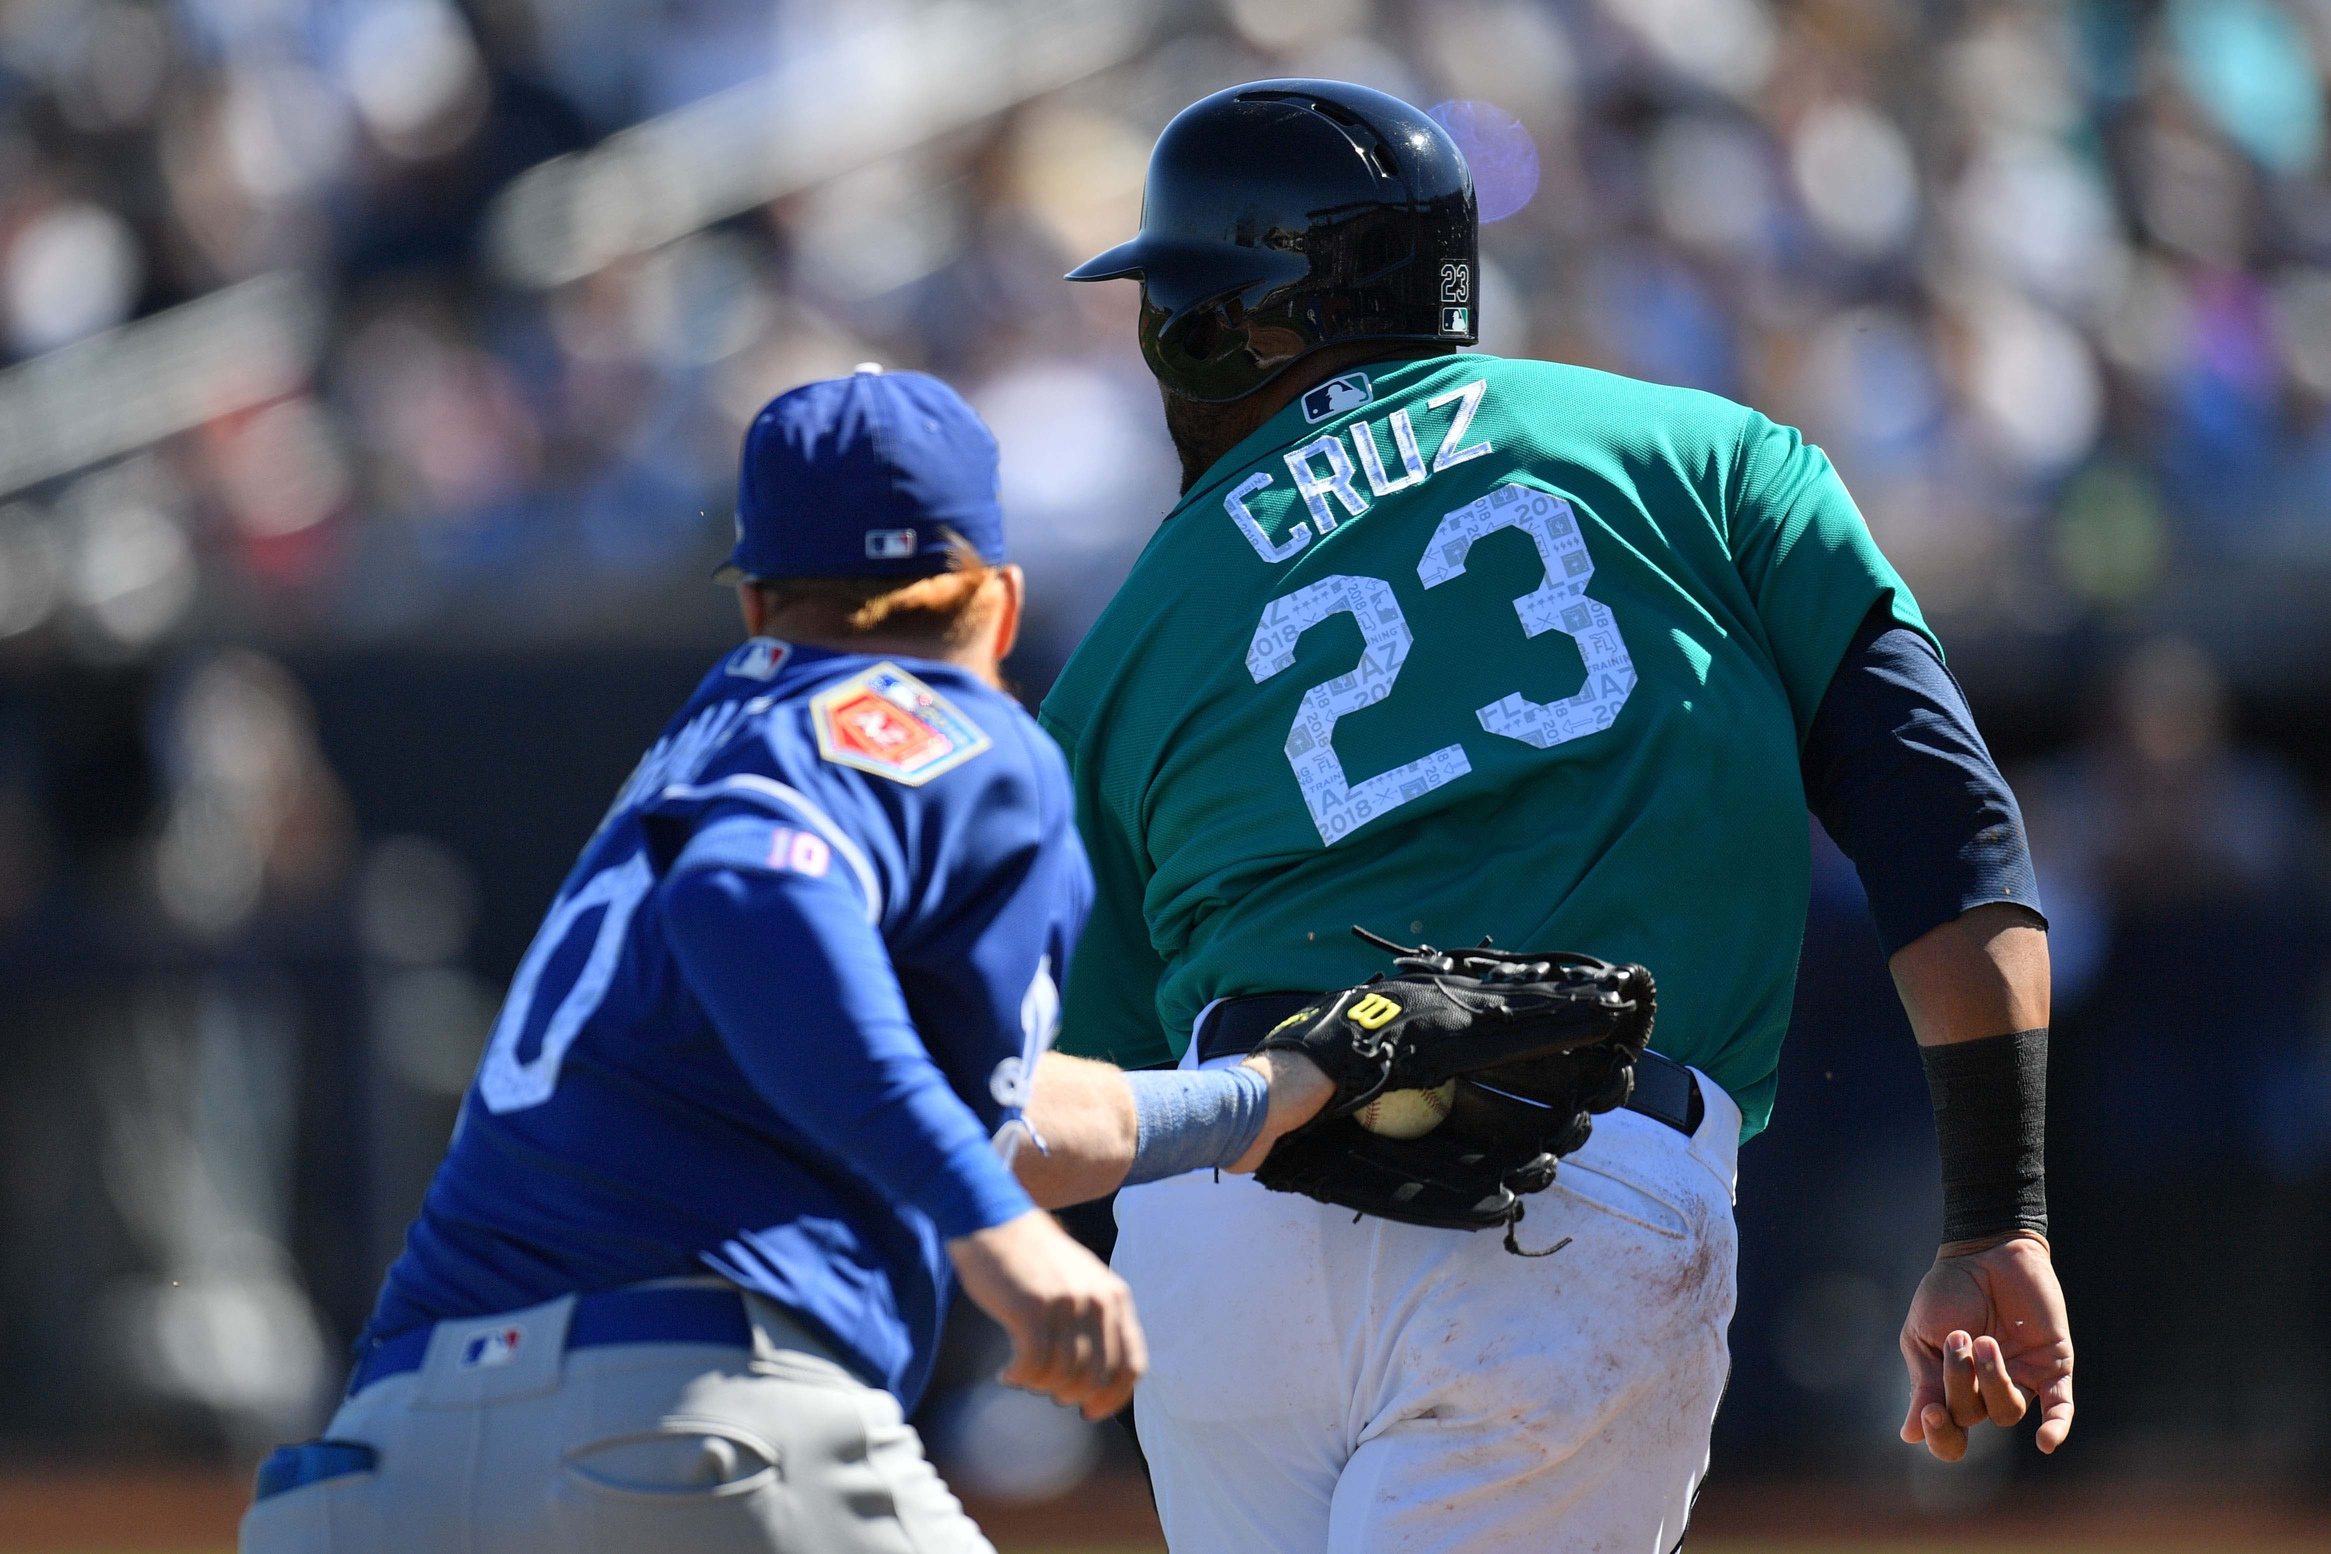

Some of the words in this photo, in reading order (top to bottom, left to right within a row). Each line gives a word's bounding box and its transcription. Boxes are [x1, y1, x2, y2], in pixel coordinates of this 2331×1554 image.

[1441, 264, 1469, 302] 23
[1223, 379, 1493, 563] CRUZ
[1246, 483, 1639, 848] 23
[1306, 712, 1330, 748] 2018
[767, 828, 831, 878] 10
